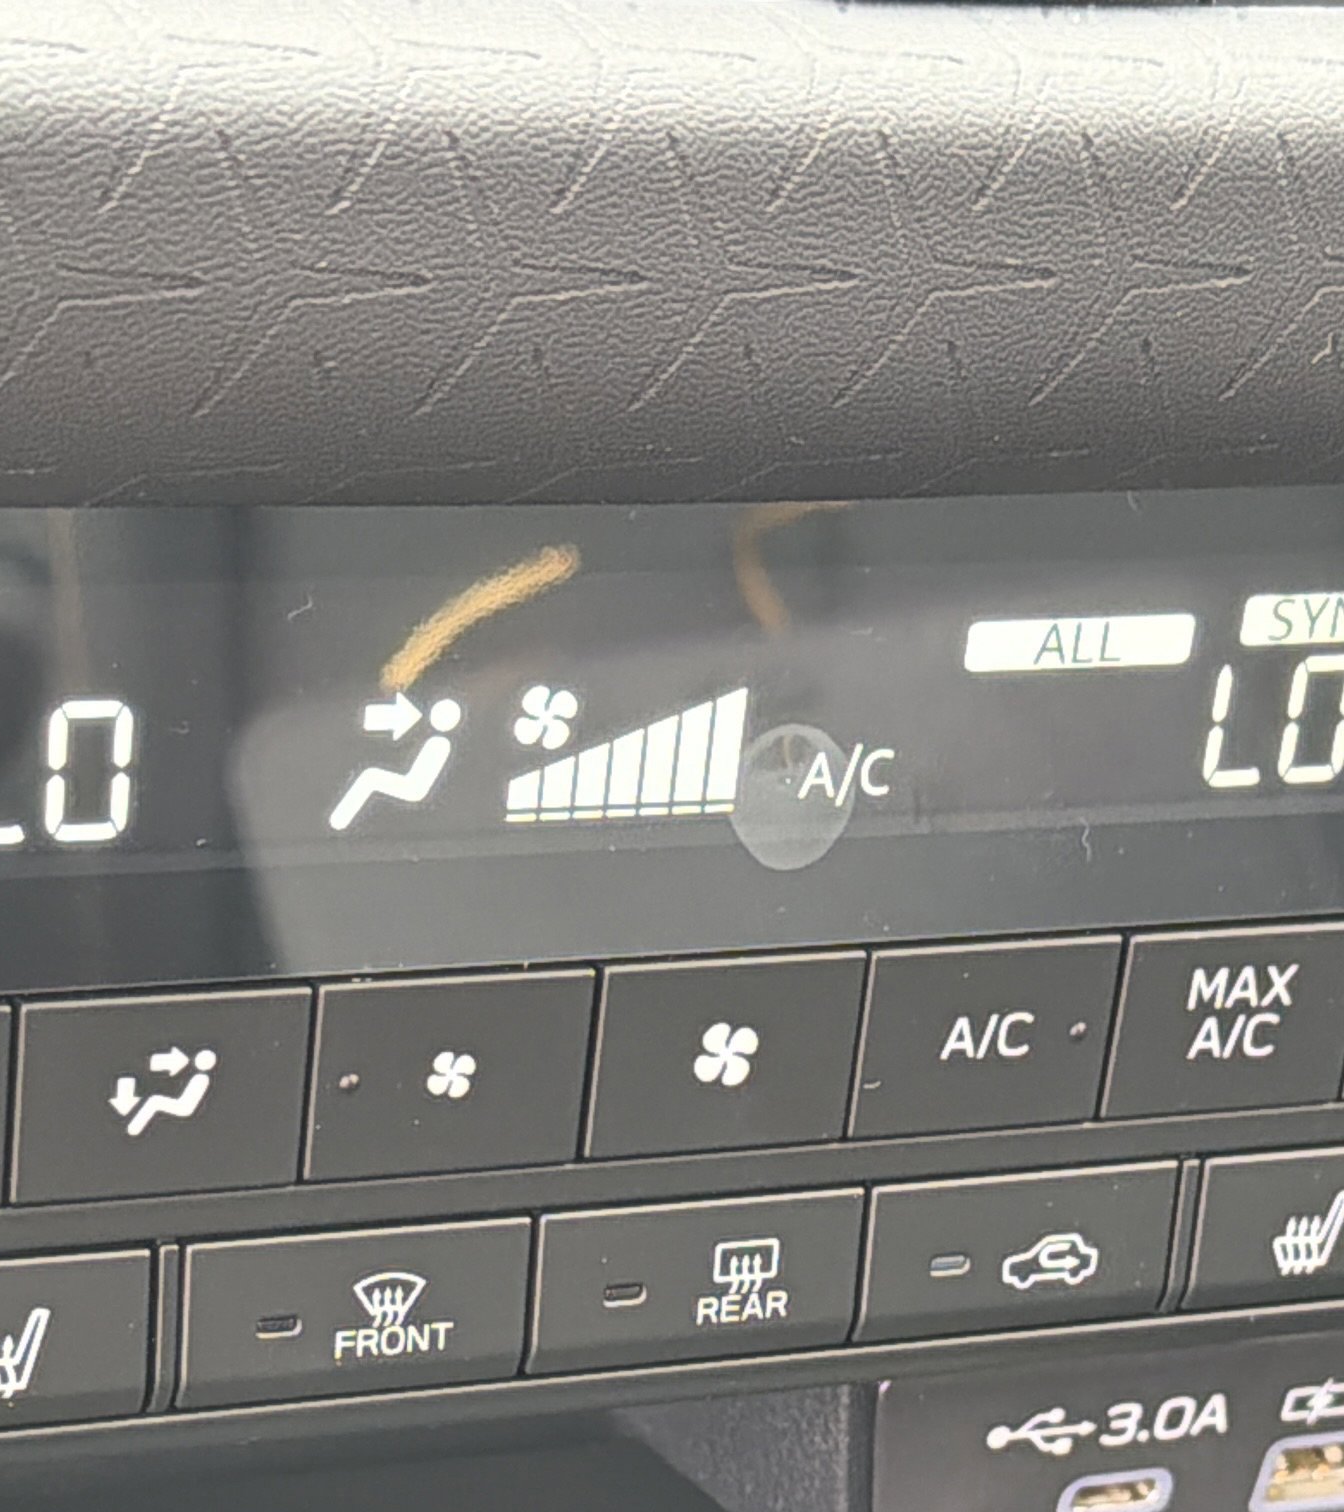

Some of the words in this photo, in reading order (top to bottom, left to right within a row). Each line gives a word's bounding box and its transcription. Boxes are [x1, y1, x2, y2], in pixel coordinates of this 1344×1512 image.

[1034, 621, 1122, 666] ALL
[798, 743, 895, 807] A/C
[1187, 963, 1300, 1010] MAX
[940, 1012, 1034, 1060] A/C
[1187, 1012, 1281, 1060] A/C
[695, 1291, 789, 1325] REAR
[334, 1322, 453, 1359] FRONT
[1097, 1394, 1229, 1448] 3.0A
